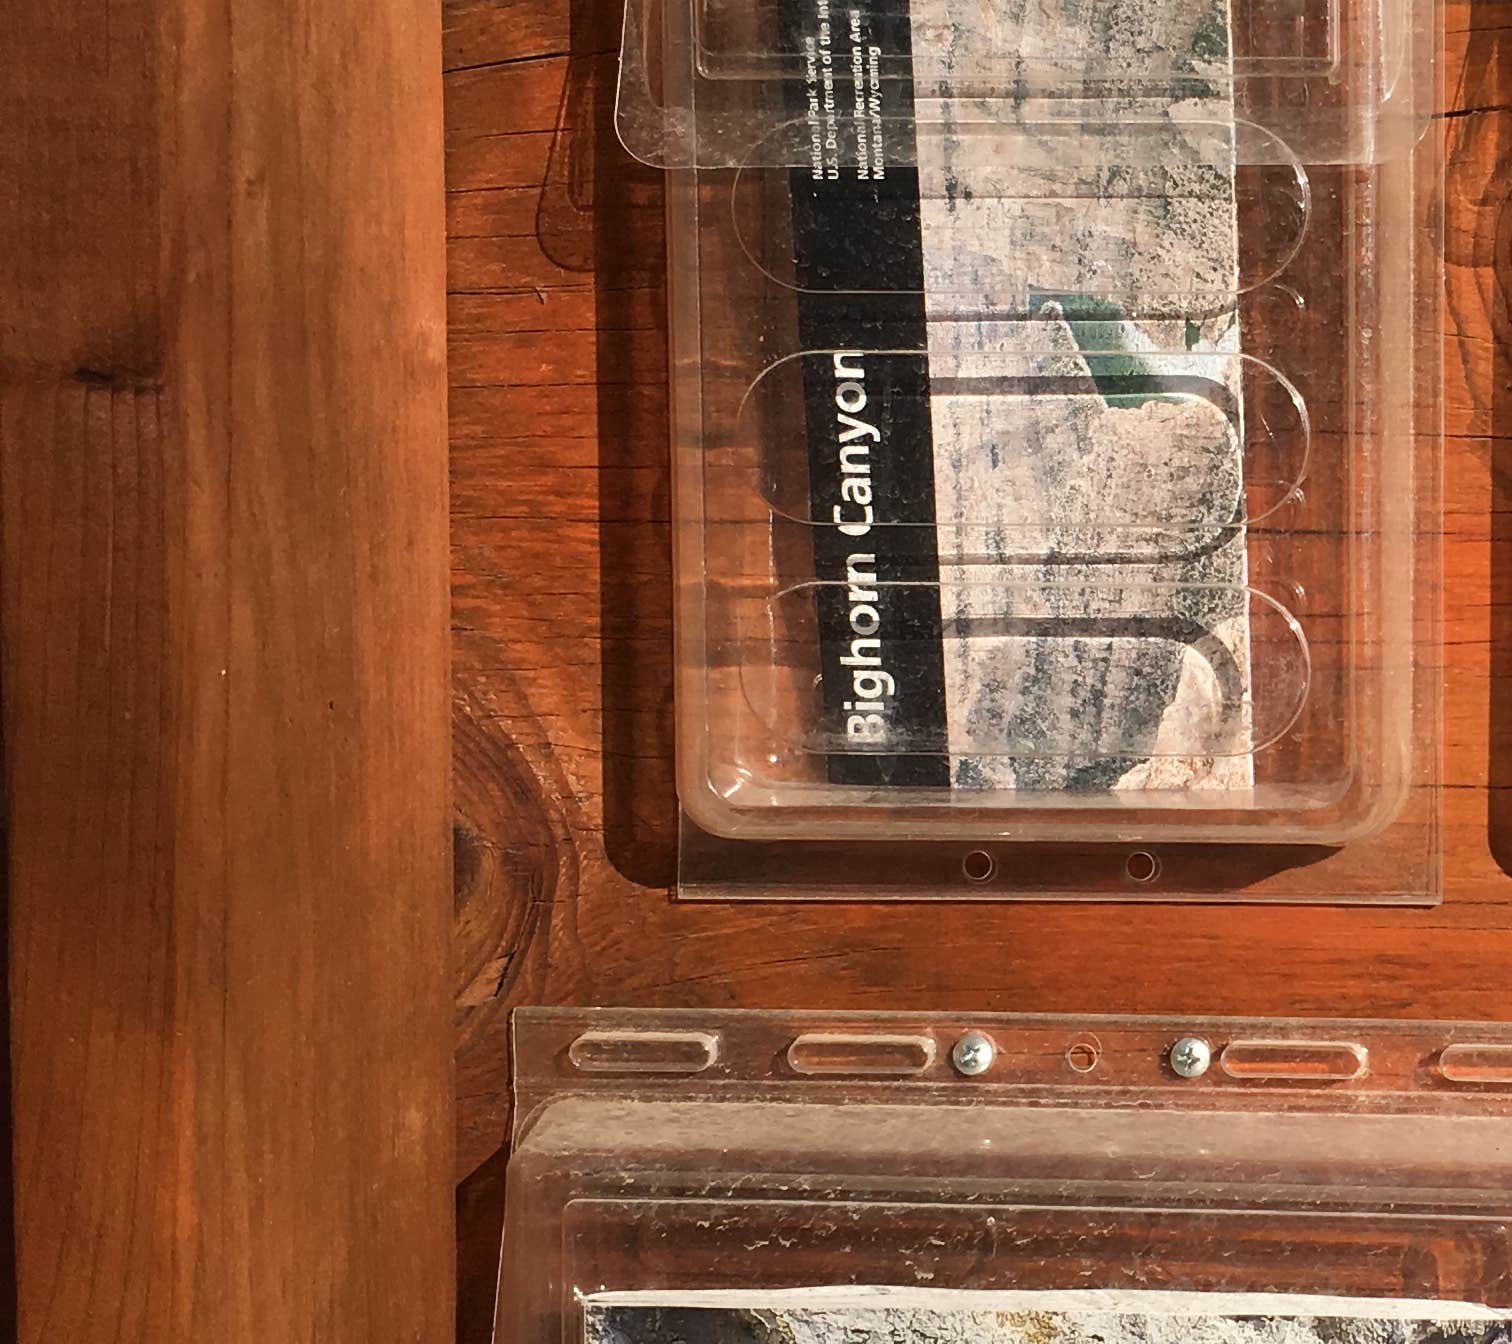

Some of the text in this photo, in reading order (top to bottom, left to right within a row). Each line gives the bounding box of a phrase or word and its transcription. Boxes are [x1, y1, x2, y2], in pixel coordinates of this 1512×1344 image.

[819, 22, 831, 46] the
[819, 49, 832, 65] of
[806, 89, 819, 119] Park
[822, 67, 838, 149] Department
[808, 121, 823, 180] National
[853, 121, 869, 180] National
[833, 349, 895, 745] Bighorn Canyon
